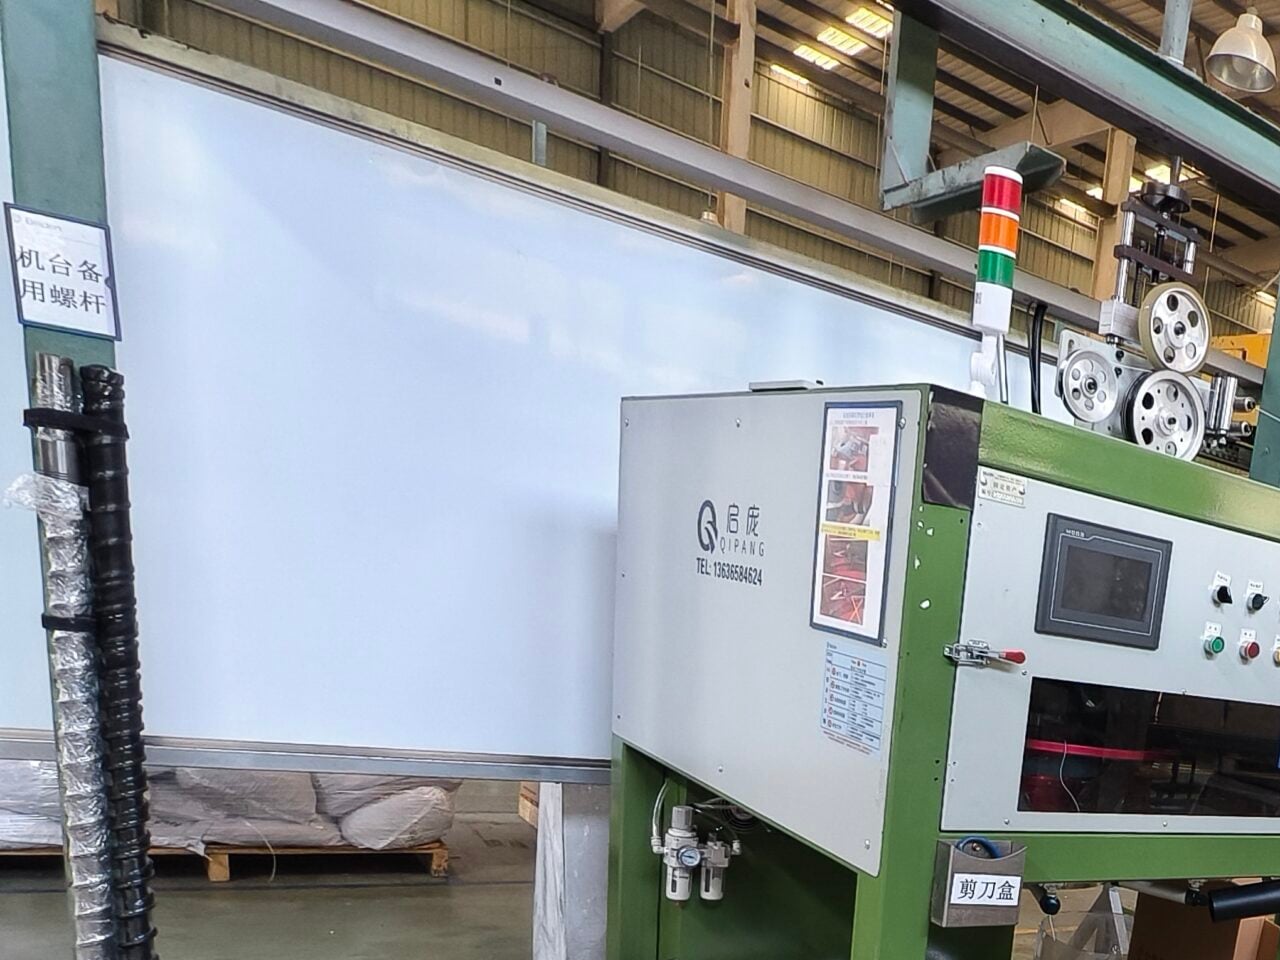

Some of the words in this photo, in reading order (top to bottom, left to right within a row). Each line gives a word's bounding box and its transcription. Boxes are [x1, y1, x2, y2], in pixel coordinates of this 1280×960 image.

[15, 245, 103, 283] 机台备
[20, 278, 106, 314] 用螺杆
[720, 536, 765, 557] QIPANG
[713, 561, 763, 587] 13636584624
[957, 878, 1016, 901] 剪刀盒
